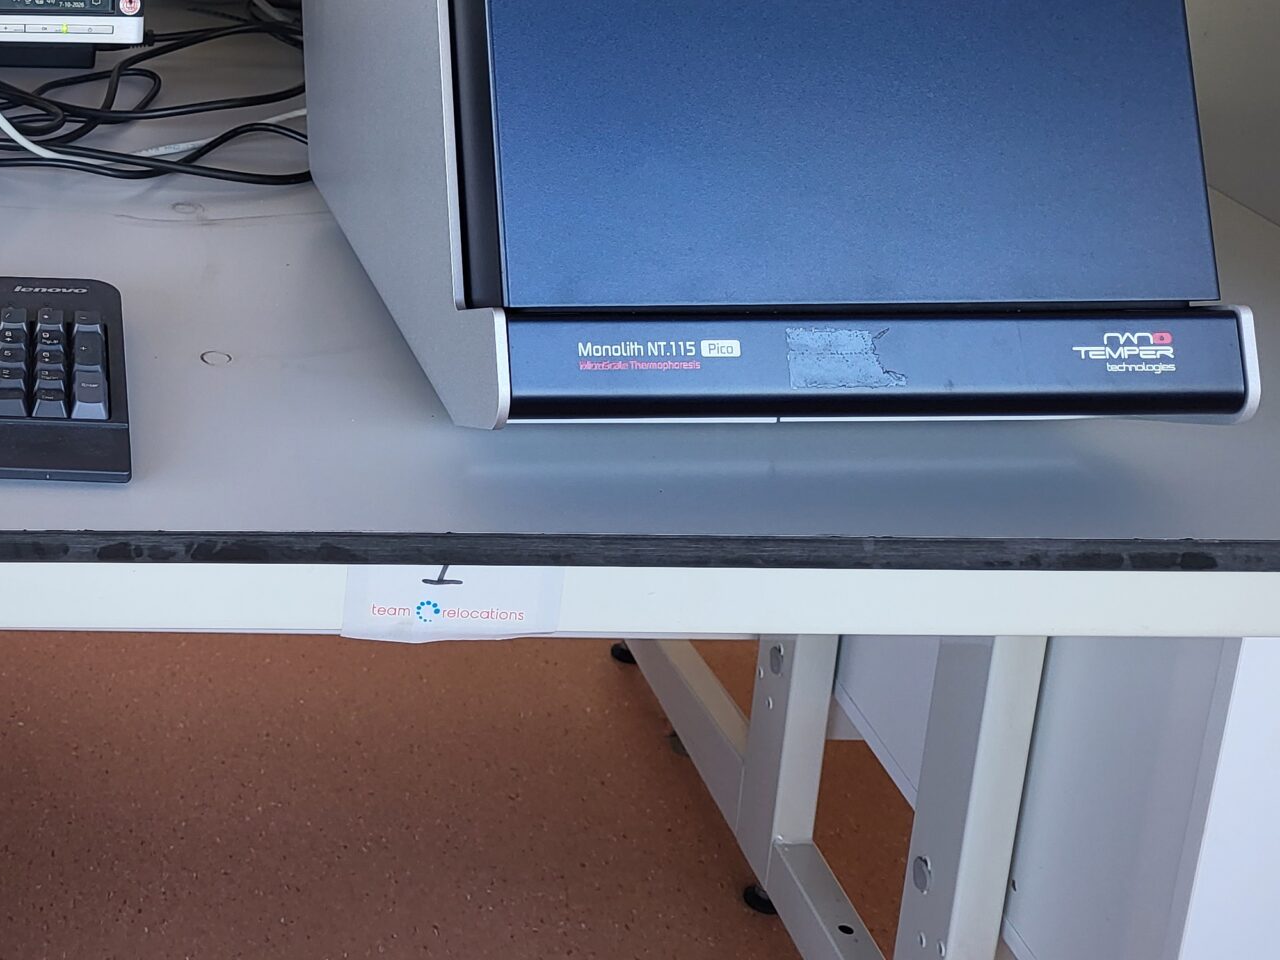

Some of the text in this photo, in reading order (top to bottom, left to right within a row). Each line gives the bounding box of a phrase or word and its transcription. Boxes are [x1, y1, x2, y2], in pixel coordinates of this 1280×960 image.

[578, 342, 733, 356] Monolith NT.115 Pico
[1072, 346, 1174, 359] TEMPER
[630, 361, 700, 371] Thermophoresis
[1107, 362, 1176, 374] technologies
[372, 604, 524, 621] team relocations
